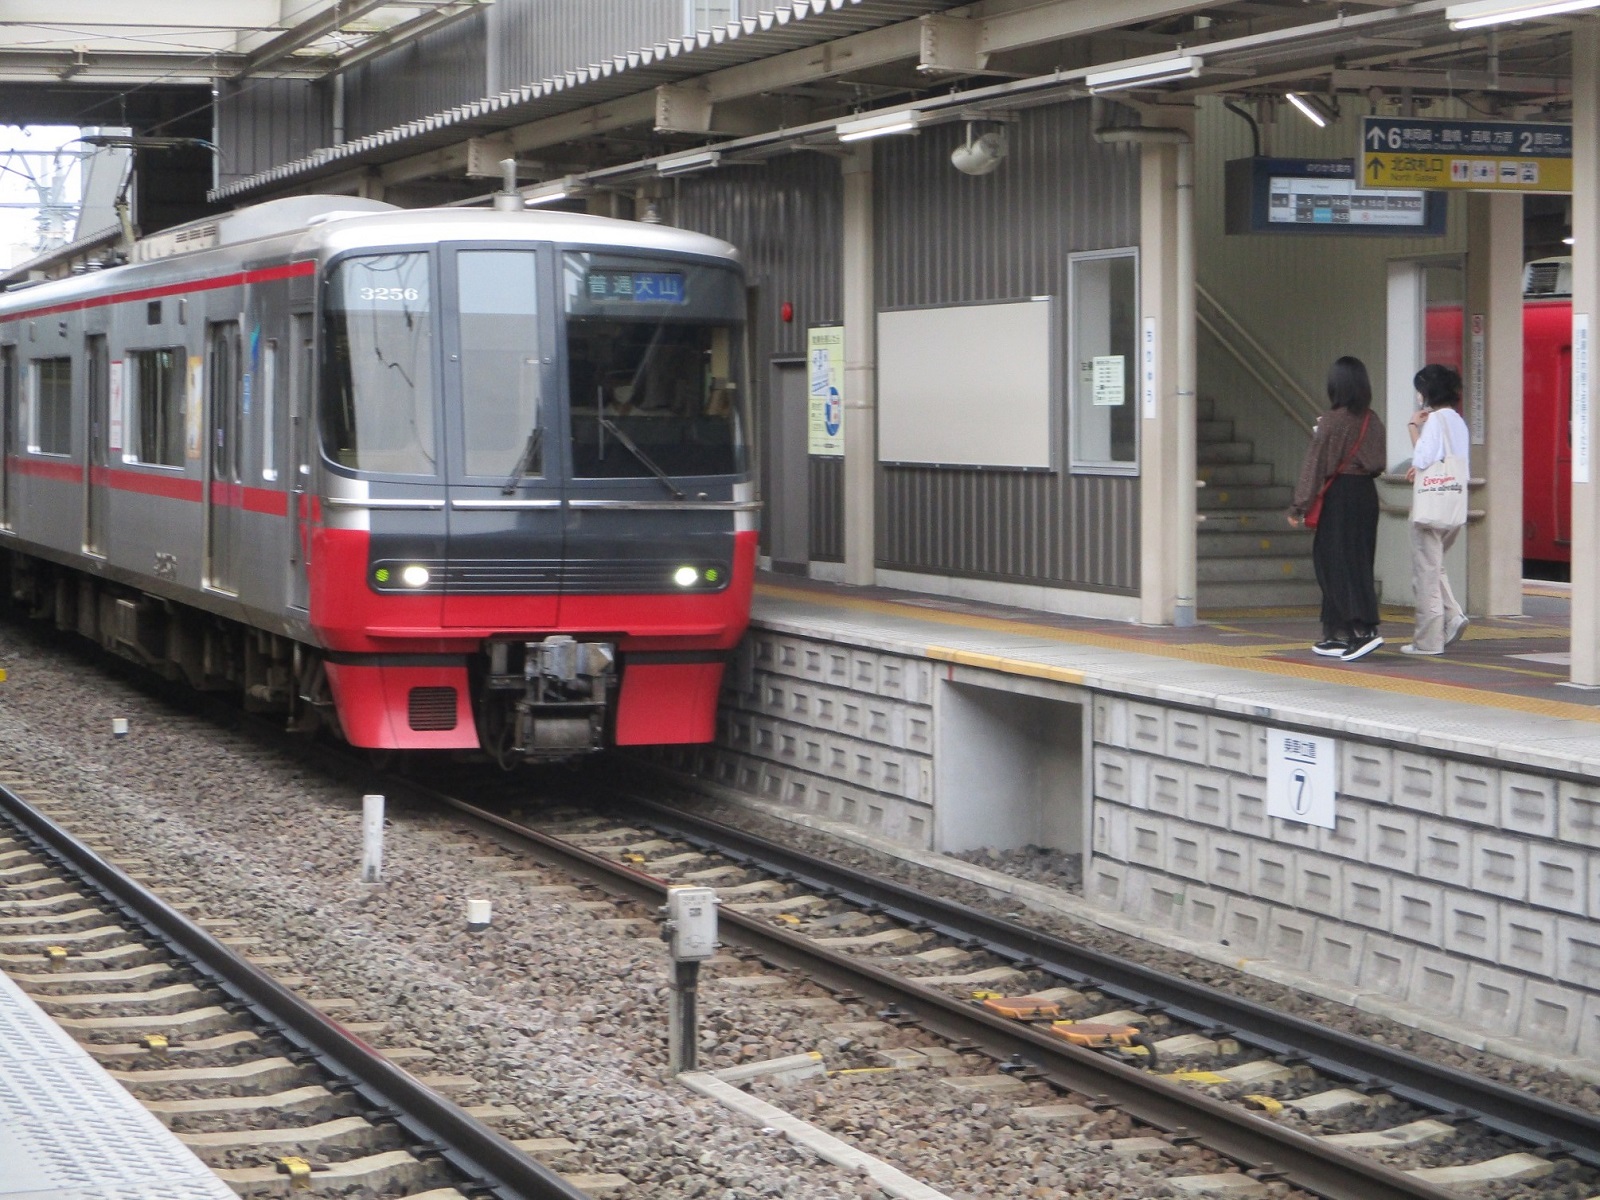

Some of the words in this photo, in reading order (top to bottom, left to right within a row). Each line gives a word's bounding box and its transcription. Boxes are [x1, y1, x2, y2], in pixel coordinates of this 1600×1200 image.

[1387, 127, 1401, 149] 6
[1519, 131, 1533, 153] 2
[1391, 157, 1443, 172] 北改札口
[360, 287, 419, 301] 3256
[588, 275, 633, 294] 普通
[635, 277, 678, 296] 犬山
[1295, 774, 1305, 811] 7
